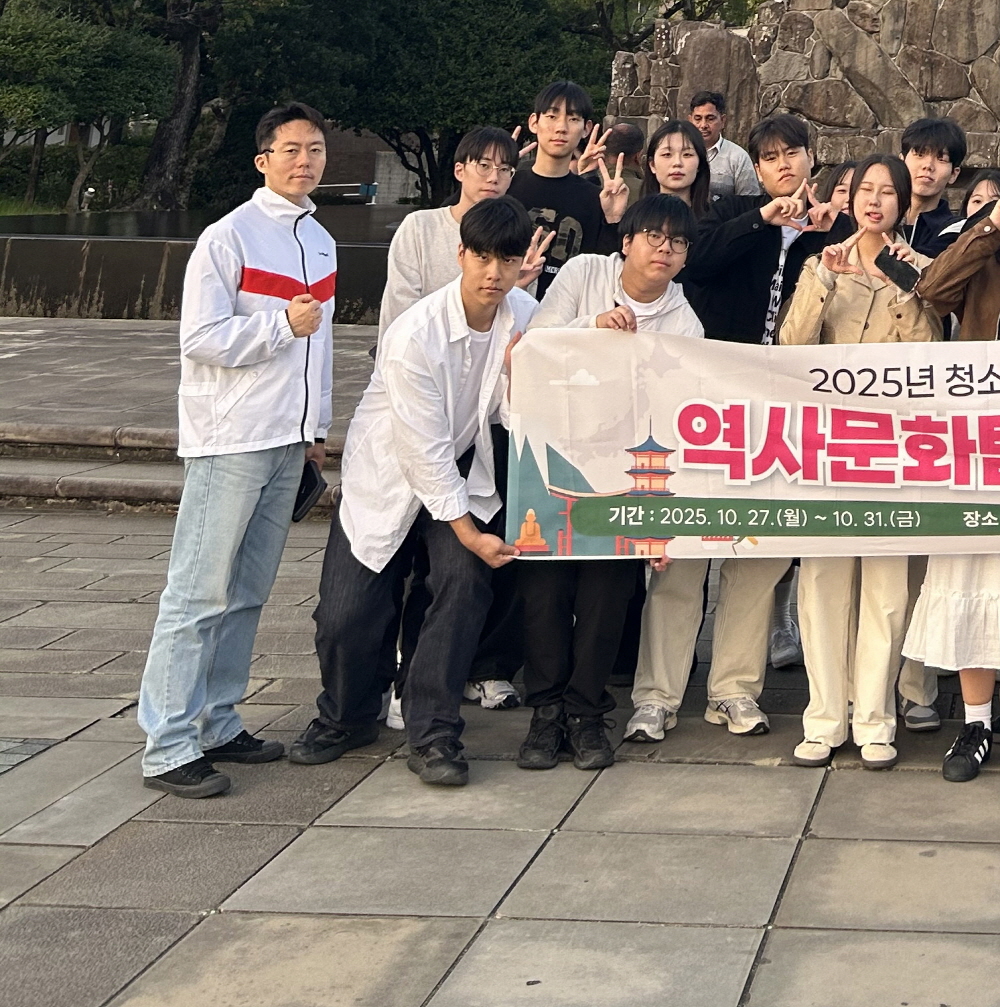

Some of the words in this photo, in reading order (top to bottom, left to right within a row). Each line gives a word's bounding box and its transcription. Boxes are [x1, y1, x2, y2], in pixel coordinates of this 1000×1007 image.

[808, 364, 935, 398] 2025년
[608, 505, 645, 526] 기간
[660, 507, 712, 525] 2025.
[717, 508, 742, 526] 10.
[747, 508, 808, 527] 27.(월)
[832, 510, 858, 527] 10.
[863, 510, 921, 528] 31.(금)
[962, 510, 999, 528] 장소
